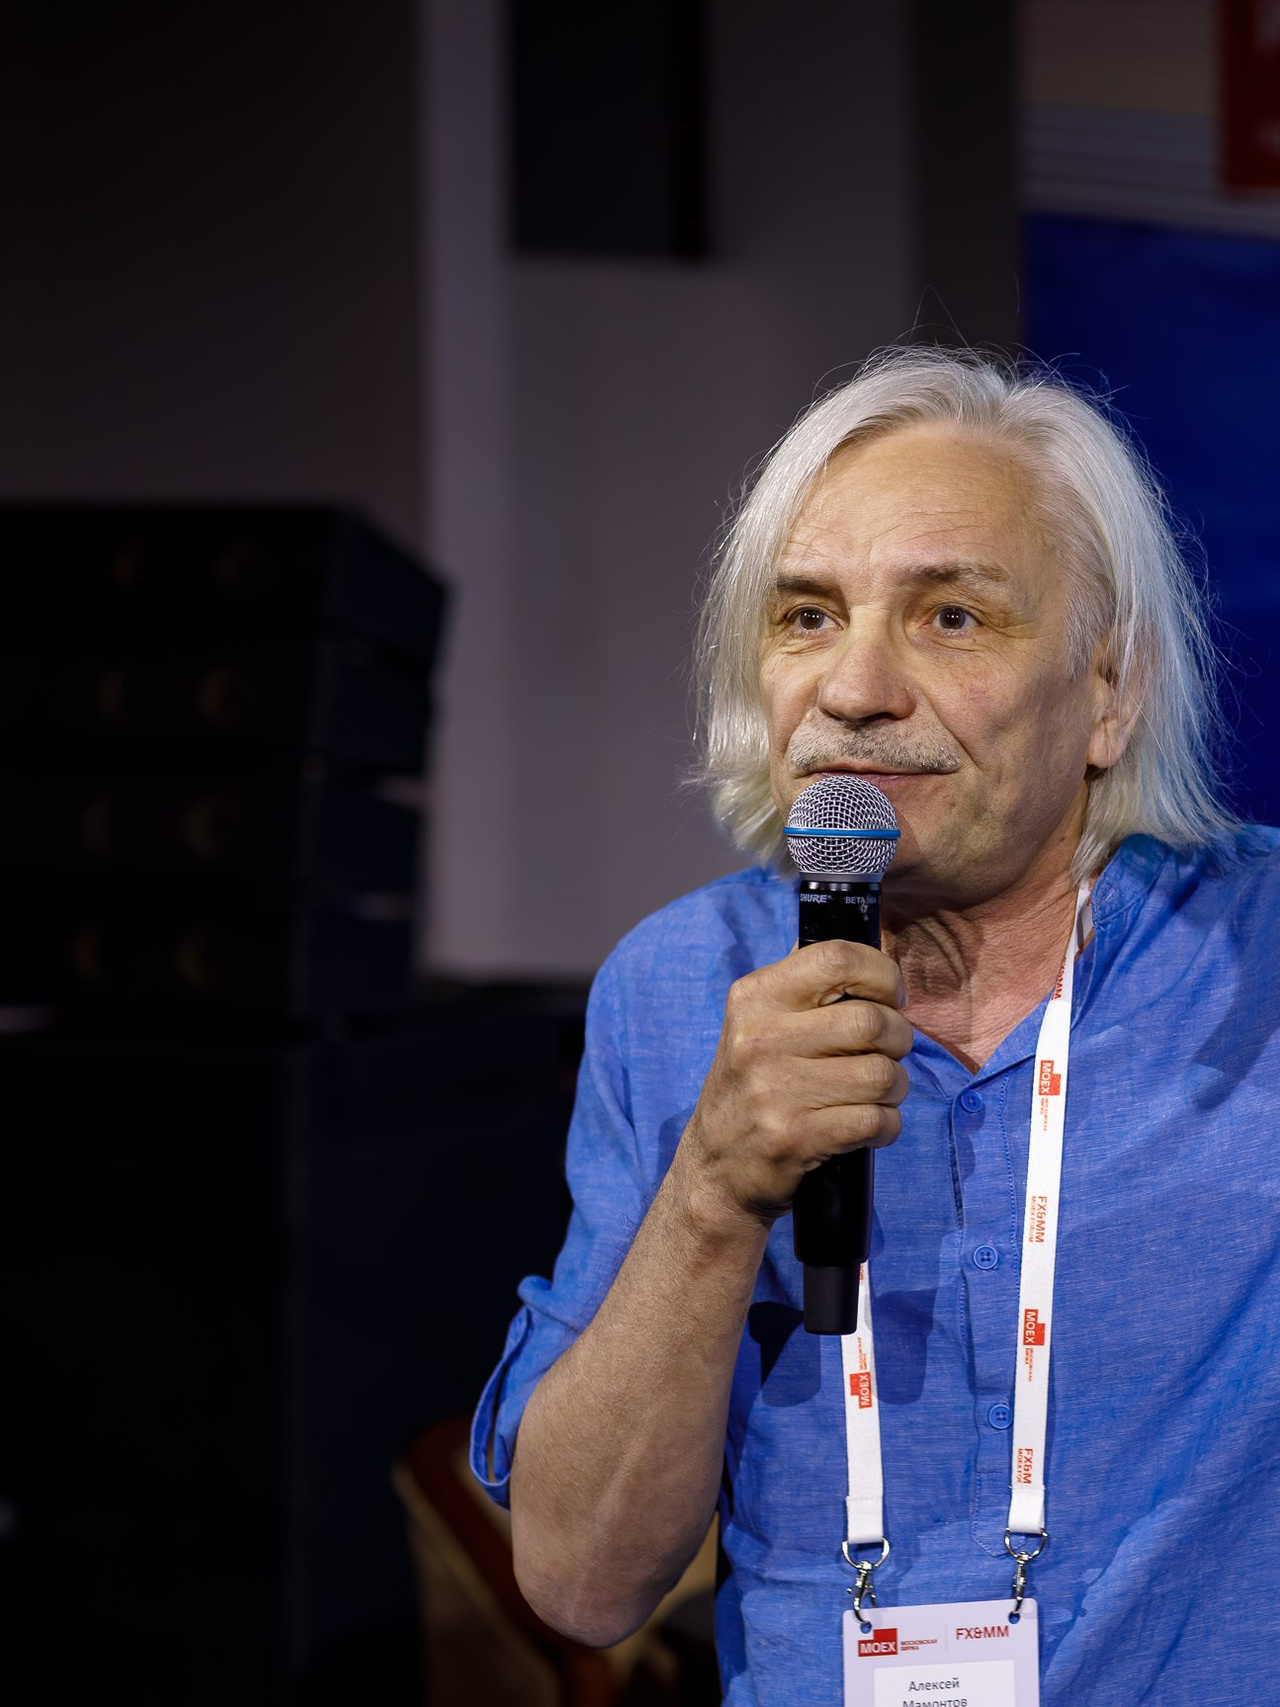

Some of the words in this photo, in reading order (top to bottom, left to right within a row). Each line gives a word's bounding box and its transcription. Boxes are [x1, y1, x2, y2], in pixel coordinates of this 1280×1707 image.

[845, 896, 865, 905] BETA
[1041, 1062, 1052, 1094] MOEX
[1035, 1196, 1048, 1243] FX&MM
[1025, 1311, 1036, 1343] MOEX
[859, 1374, 870, 1406] MOEX
[956, 1625, 1009, 1640] FX&MM
[860, 1641, 896, 1654] MOEX
[908, 1677, 960, 1692] Алексей
